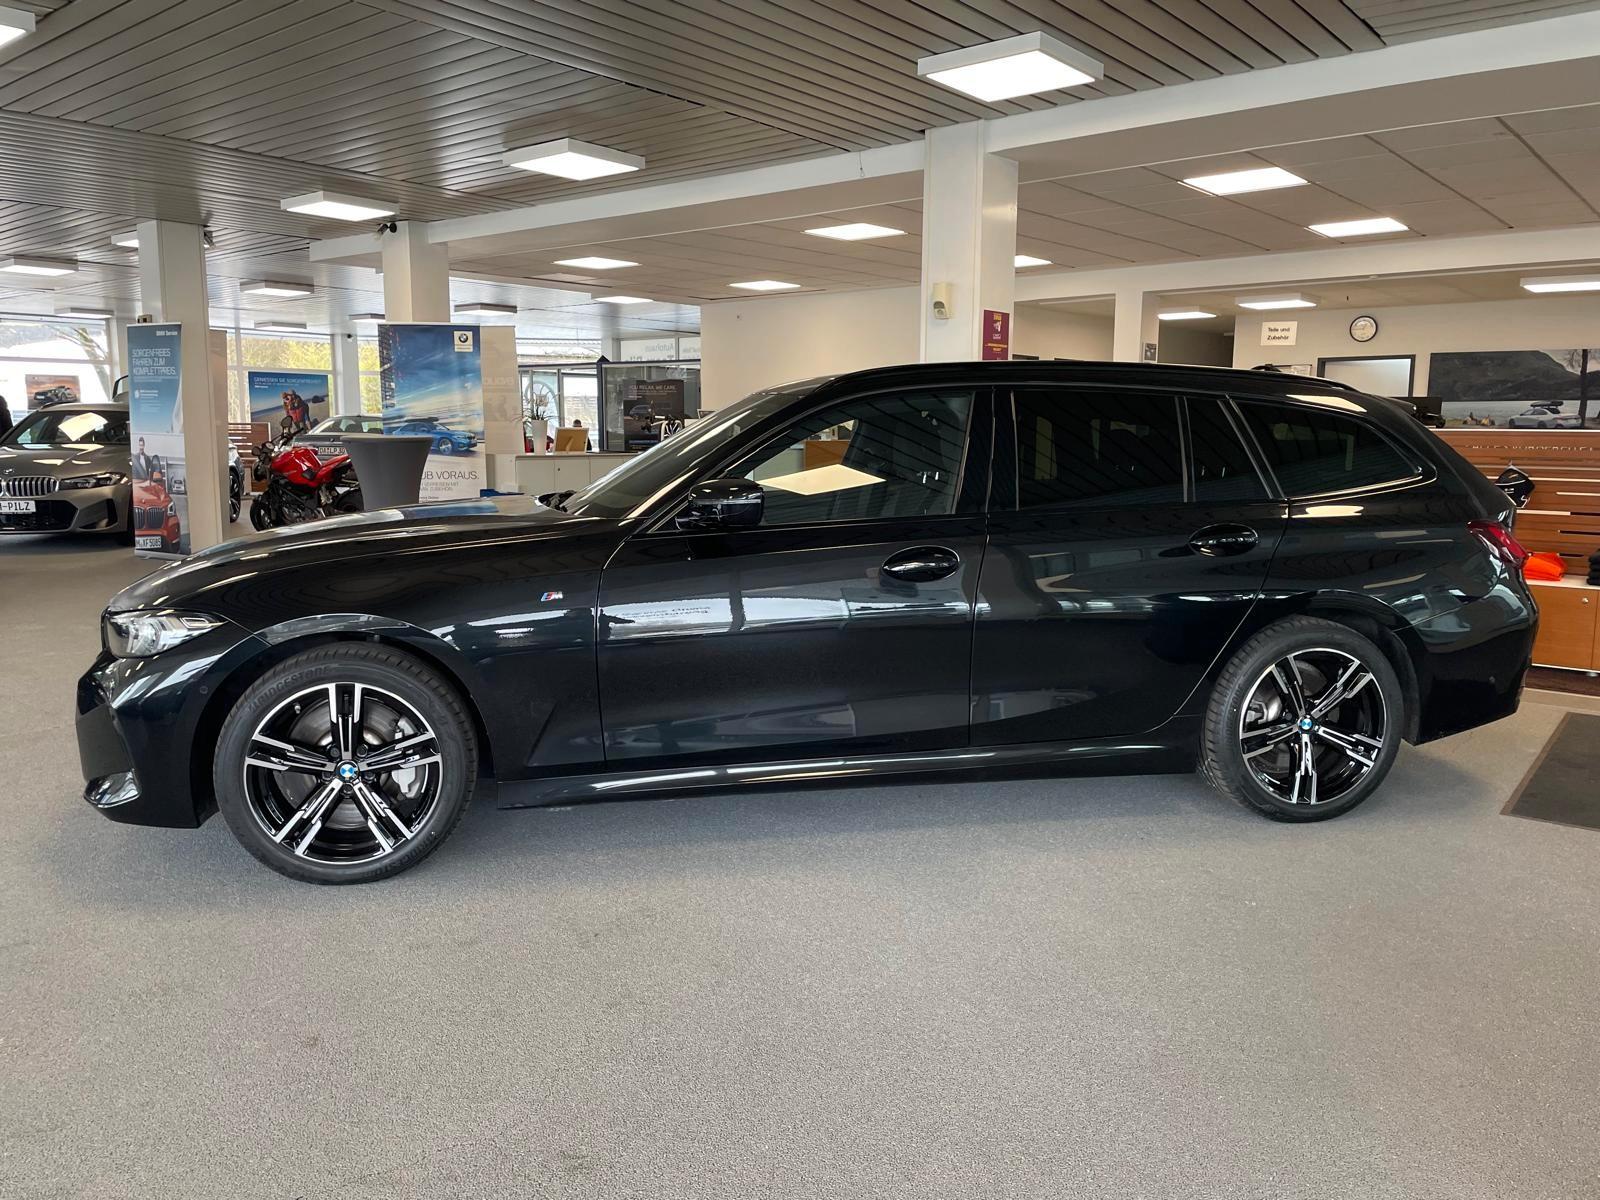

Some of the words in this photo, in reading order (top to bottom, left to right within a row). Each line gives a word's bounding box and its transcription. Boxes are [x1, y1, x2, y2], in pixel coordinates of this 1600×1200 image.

[133, 357, 153, 366] FAHREN
[153, 357, 166, 366] ZUM
[436, 470, 480, 480] VORAUS.
